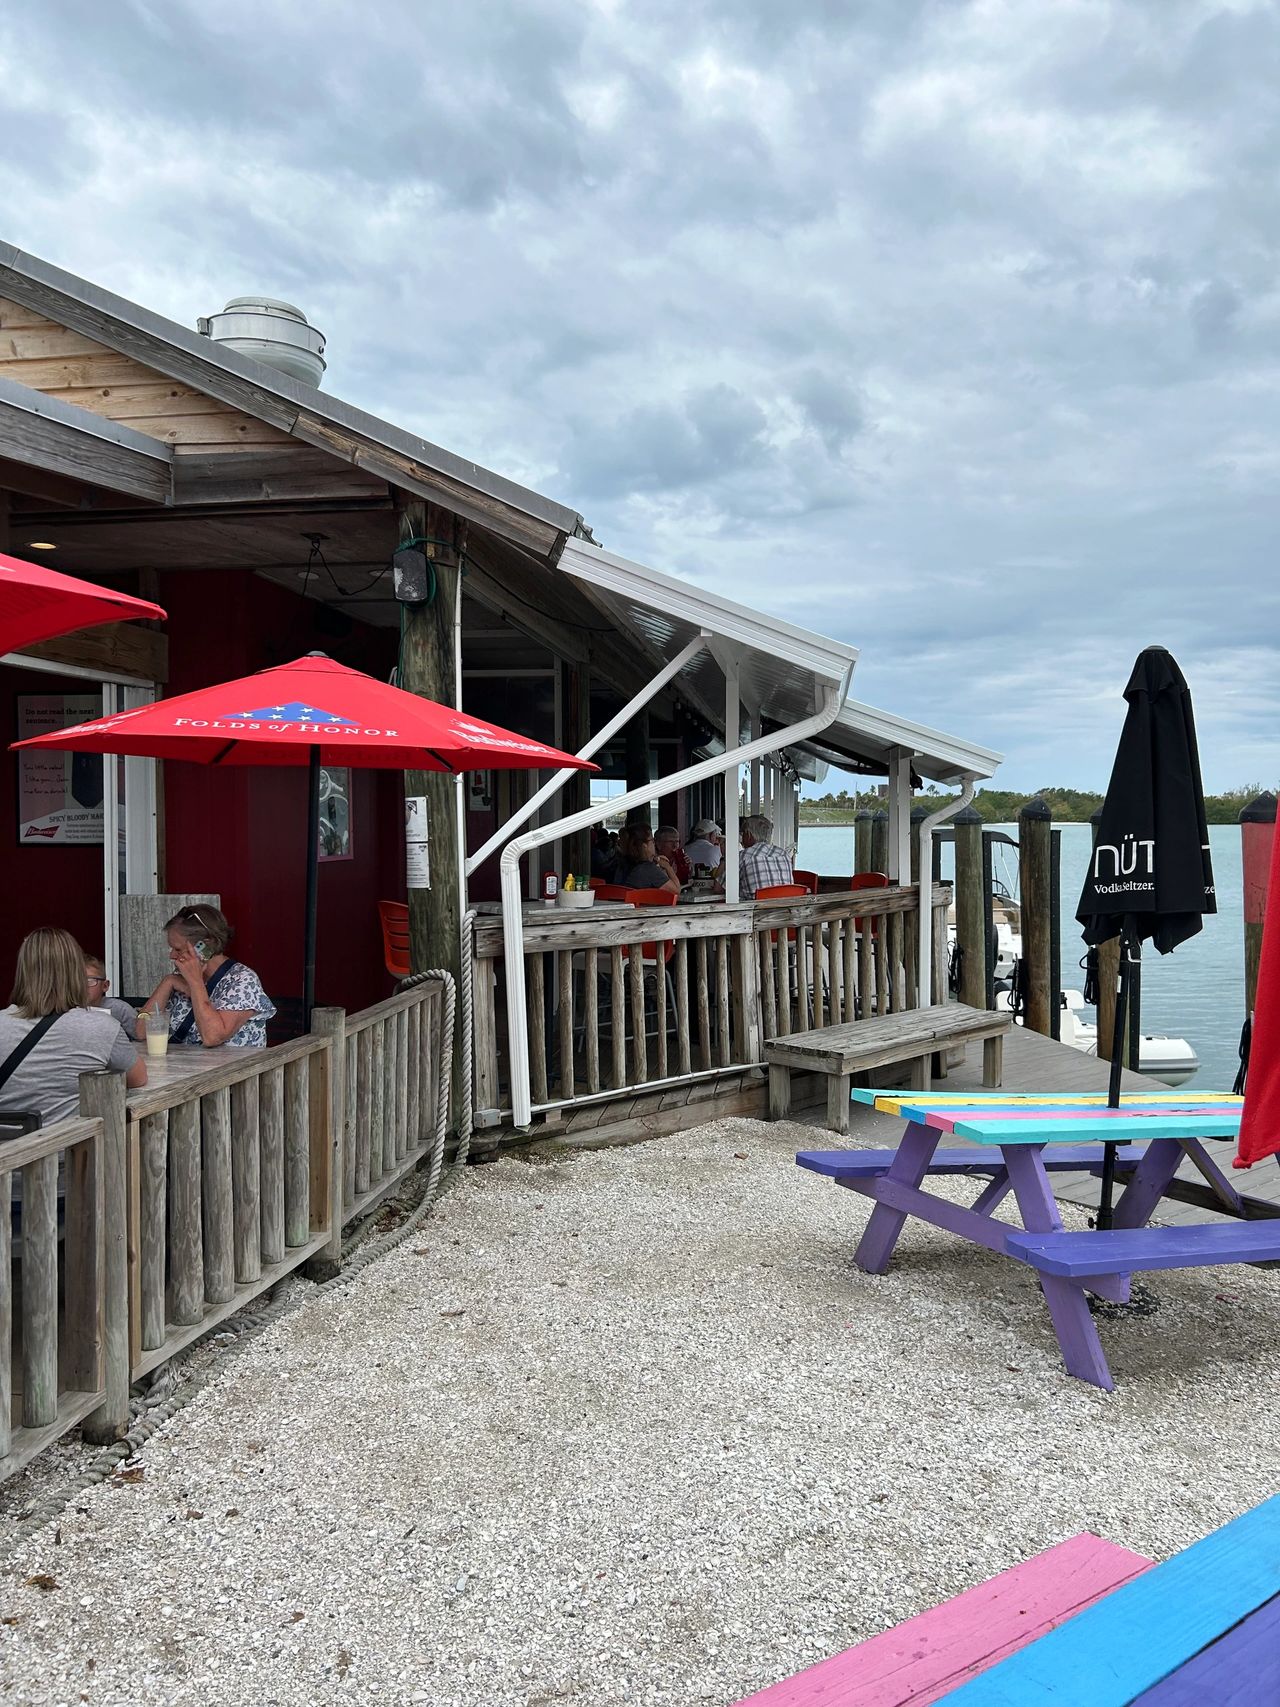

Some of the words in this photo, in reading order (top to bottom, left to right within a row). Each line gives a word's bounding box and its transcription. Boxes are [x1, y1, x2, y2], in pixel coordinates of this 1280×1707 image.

[173, 717, 260, 730] FOLDS
[268, 723, 293, 733] of
[300, 724, 399, 737] HONOR
[49, 814, 66, 823] SPICY
[67, 813, 89, 821] BLOODY
